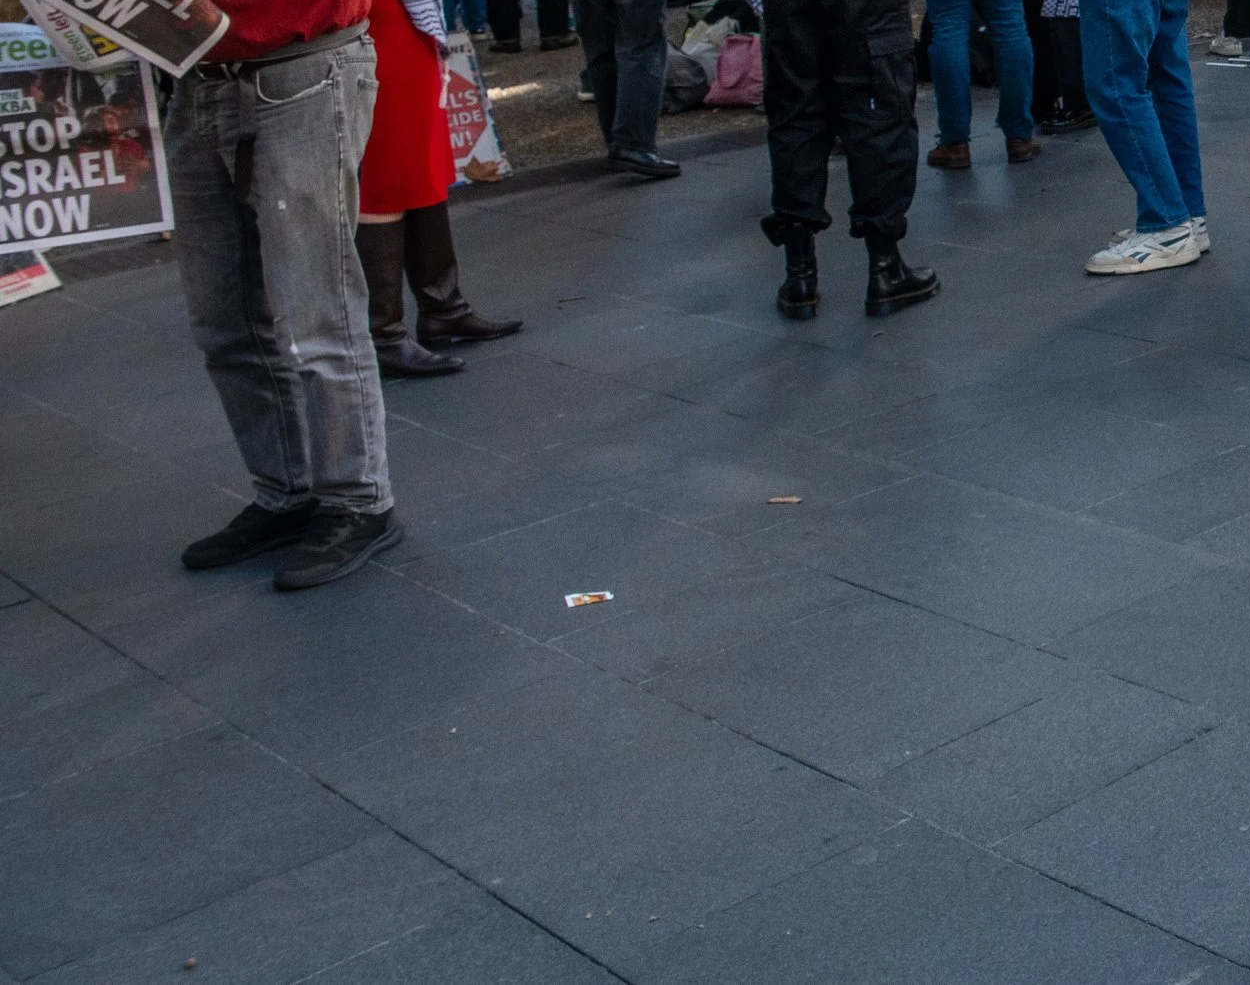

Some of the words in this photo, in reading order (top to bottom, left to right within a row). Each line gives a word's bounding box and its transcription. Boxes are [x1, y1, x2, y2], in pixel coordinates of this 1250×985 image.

[448, 110, 483, 127] IDE
[0, 150, 126, 200] SRAEL
[0, 194, 90, 242] NOW
